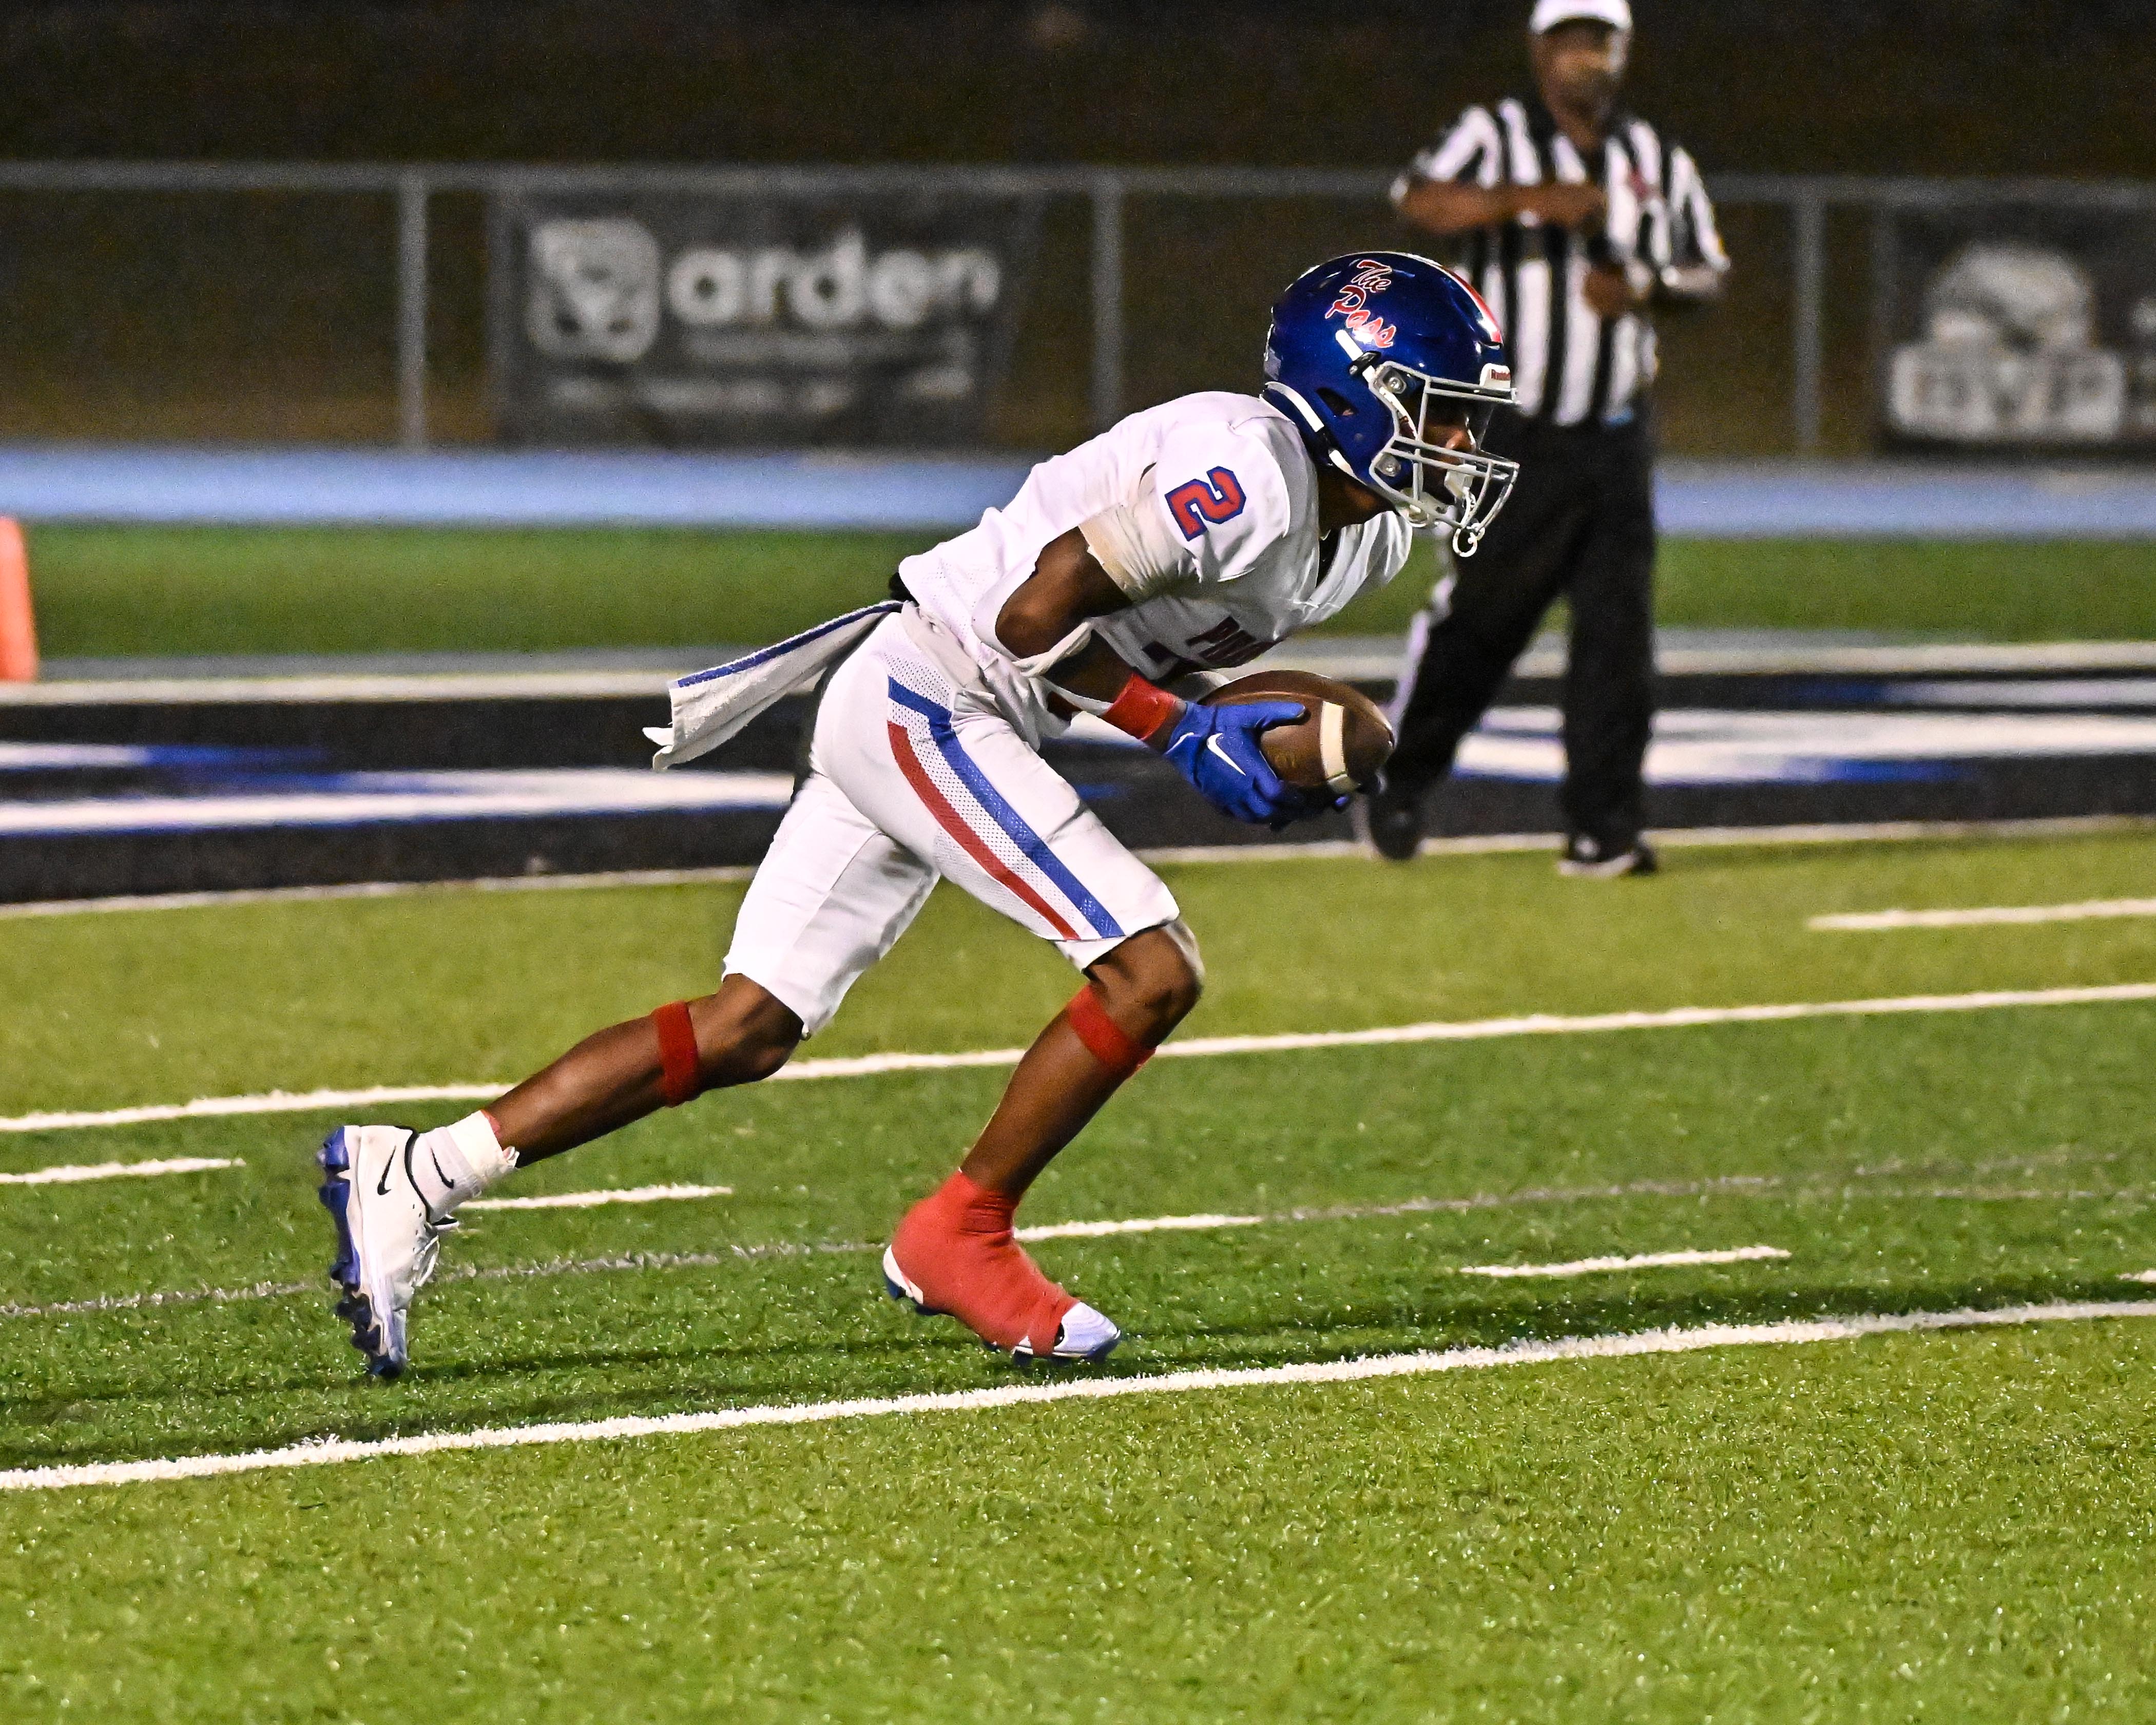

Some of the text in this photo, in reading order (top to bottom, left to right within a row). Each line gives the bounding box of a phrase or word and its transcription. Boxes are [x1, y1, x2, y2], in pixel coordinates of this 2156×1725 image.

[1351, 260, 1392, 293] The
[1325, 285, 1396, 348] Pass
[1165, 466, 1246, 541] 2
